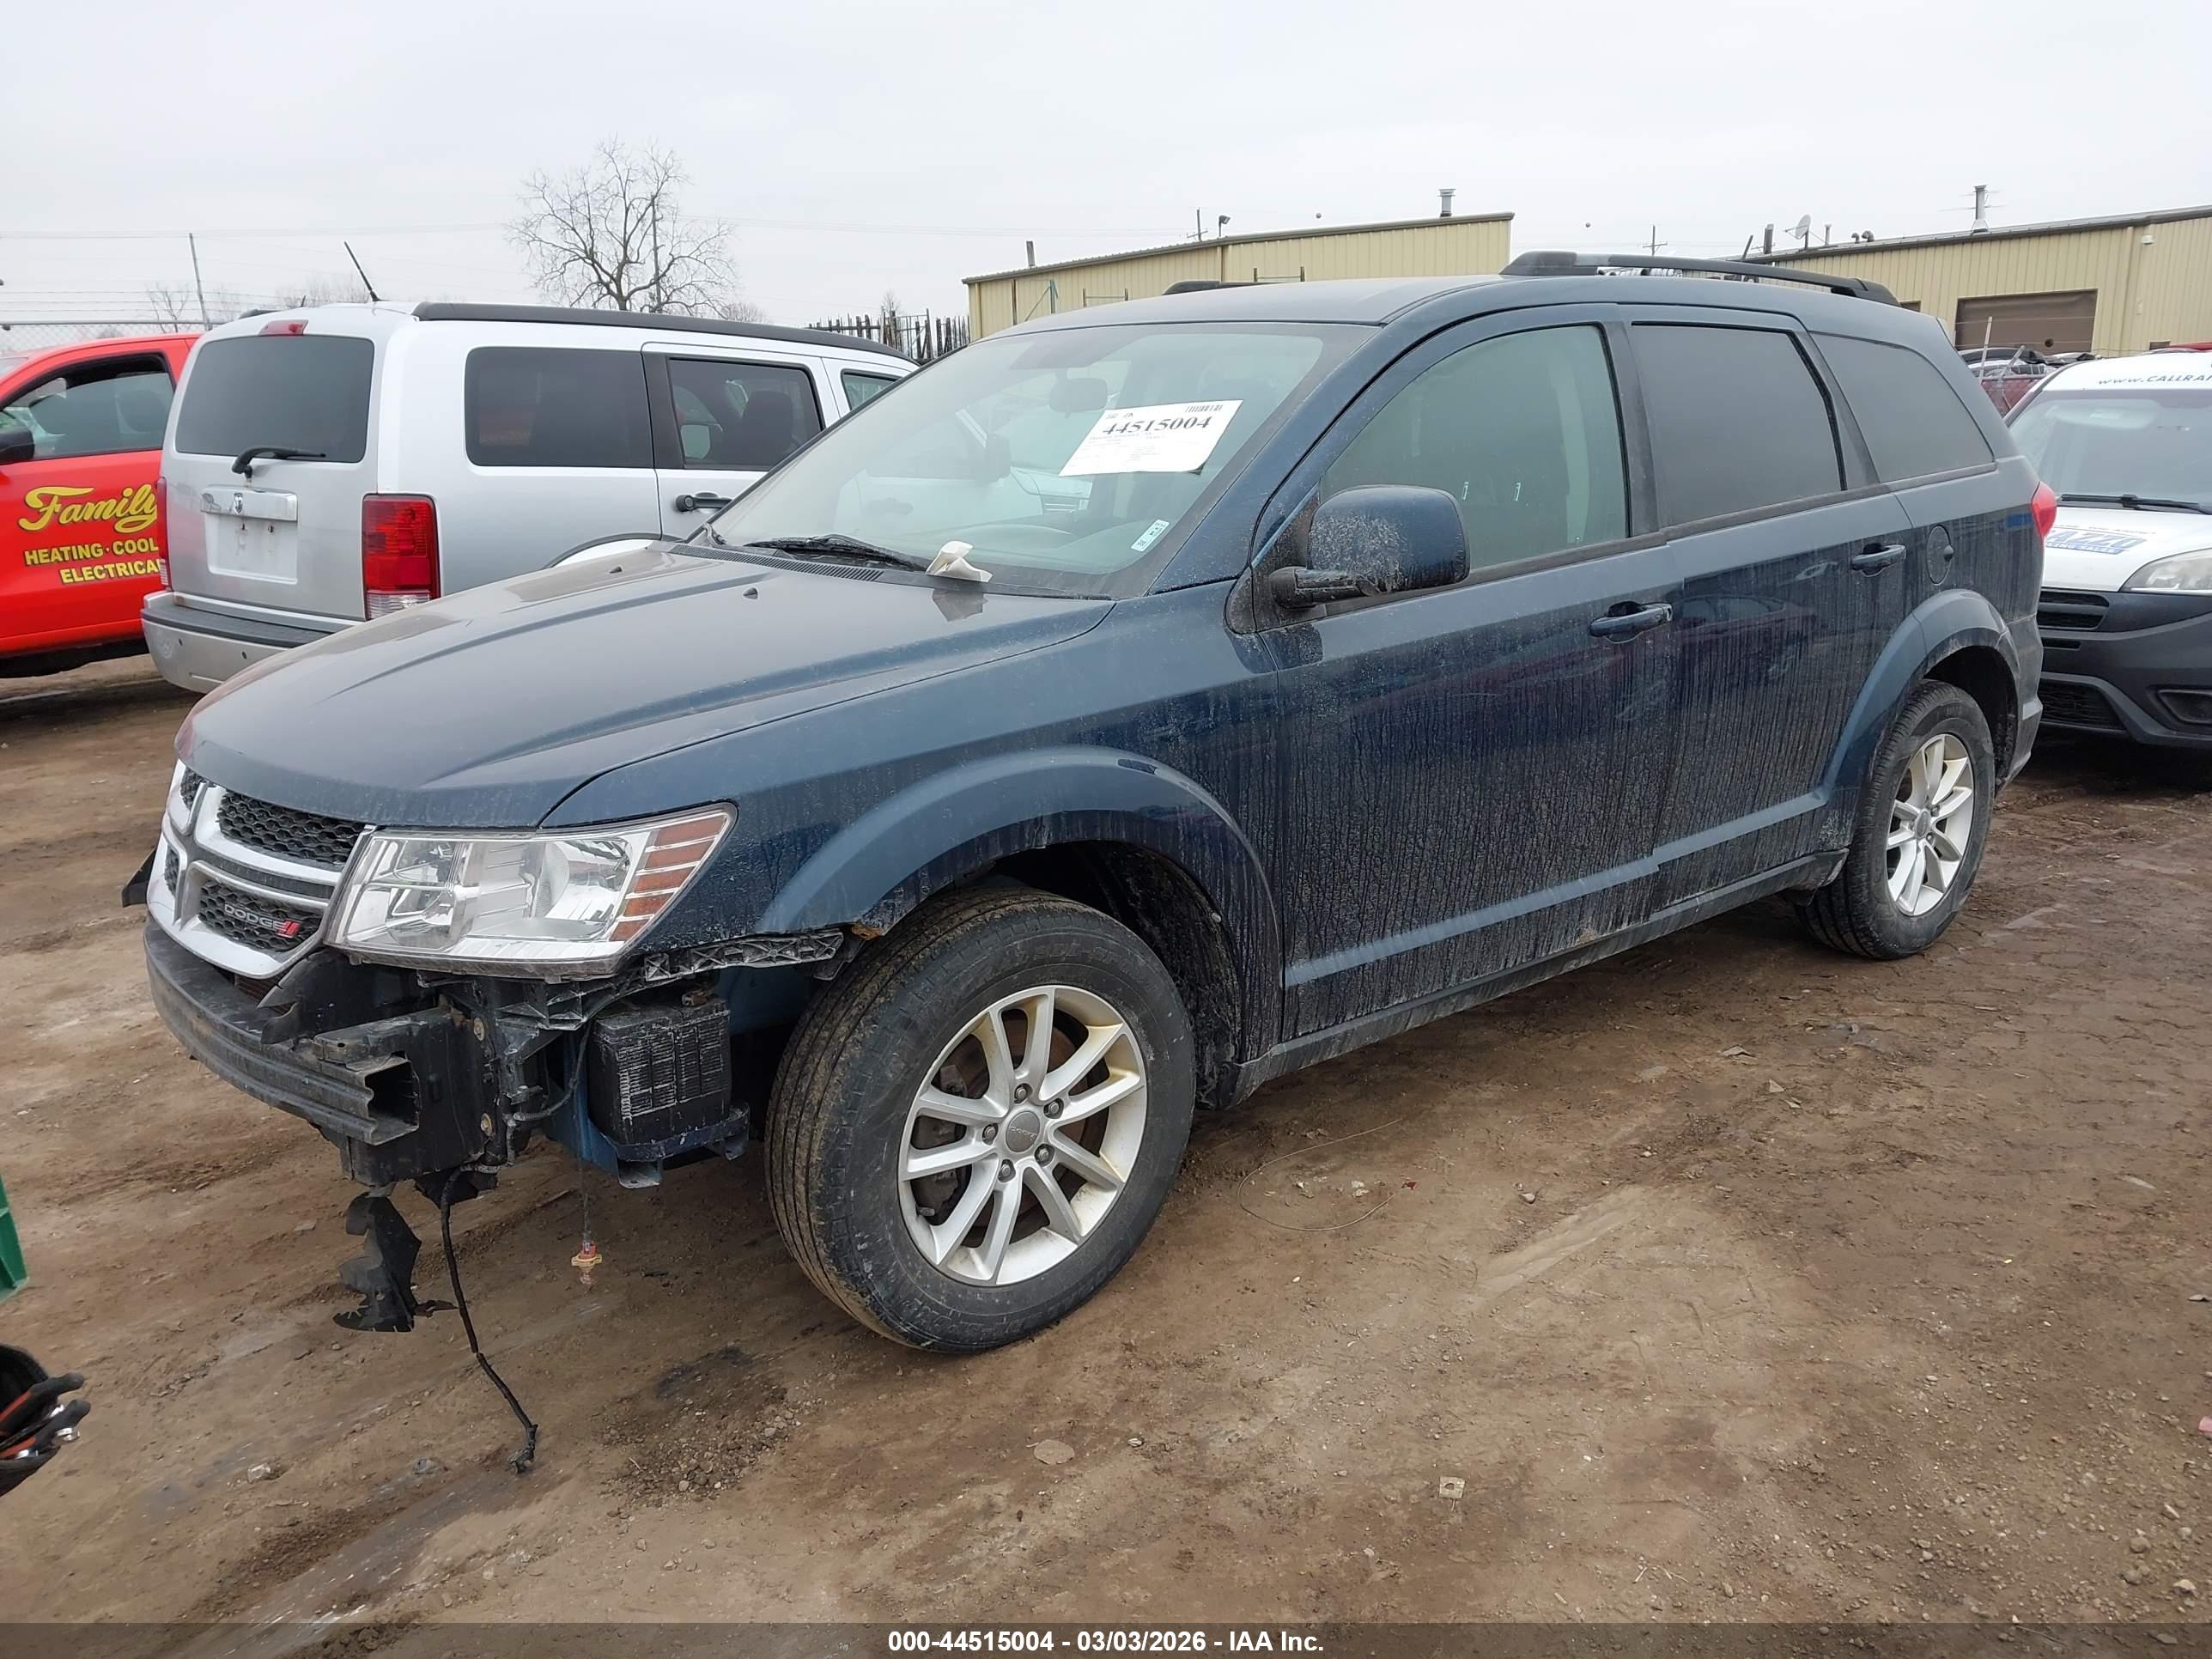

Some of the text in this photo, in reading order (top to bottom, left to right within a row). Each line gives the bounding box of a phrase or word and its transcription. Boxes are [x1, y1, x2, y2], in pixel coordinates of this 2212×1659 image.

[1103, 416, 1212, 434] 44515004
[18, 484, 157, 533] Family
[24, 543, 104, 566] HEATING
[224, 903, 287, 933] DODGE
